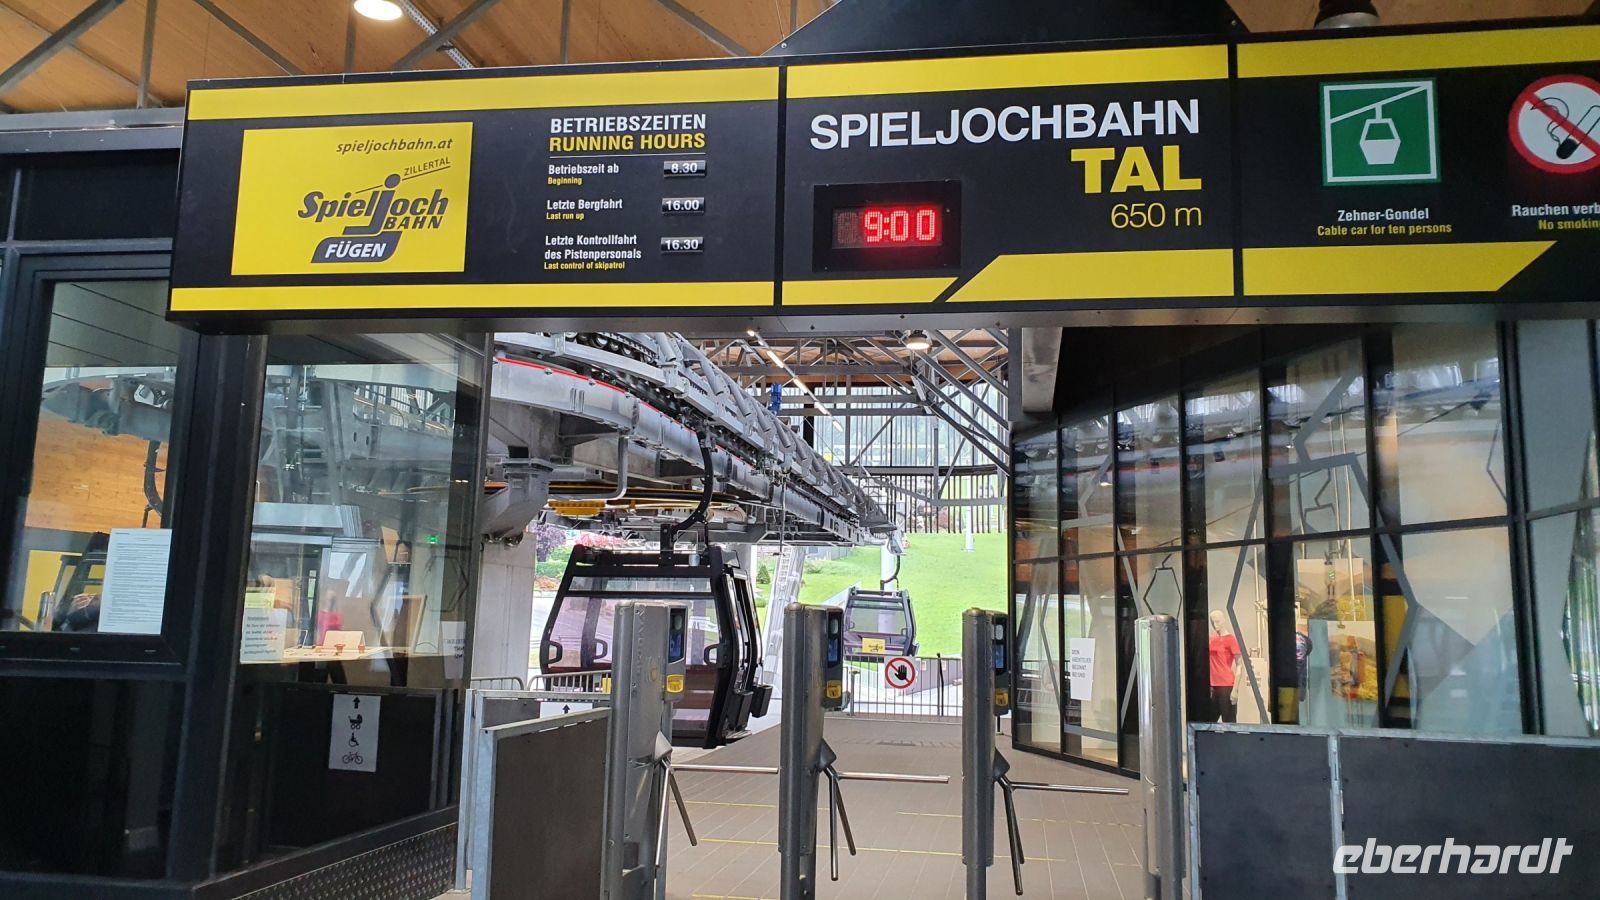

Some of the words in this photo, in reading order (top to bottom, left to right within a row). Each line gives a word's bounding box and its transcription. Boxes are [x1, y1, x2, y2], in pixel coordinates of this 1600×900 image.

[550, 113, 706, 134] BETRIEBSZEITEN
[810, 99, 1200, 150] SPIELJOCHBAHN
[336, 137, 453, 155] spieljochbahn.at
[549, 134, 634, 152] RUNNING
[640, 132, 705, 150] HOURS
[403, 156, 451, 176] ZILLERTAL
[548, 164, 605, 175] Betriebszeit
[607, 163, 620, 173] ab
[671, 162, 698, 174] 8.30
[1071, 144, 1203, 194] TAL
[547, 176, 583, 186] Beginning
[297, 173, 449, 235] Spieljoch
[546, 199, 576, 210] Letzte
[578, 199, 623, 211] Bergfahrt
[666, 199, 700, 211] 16.00
[1511, 203, 1570, 217] Rauchen
[546, 212, 561, 221] Last
[575, 213, 585, 221] up
[1111, 203, 1165, 229] 650
[1174, 207, 1202, 226] m
[1337, 207, 1429, 221] Zehner-Gondel
[383, 216, 443, 230] BAHN
[864, 209, 936, 243] 9:00
[1317, 225, 1348, 236] Cable
[1370, 224, 1386, 234] for
[1388, 224, 1406, 234] ten
[1408, 224, 1452, 236] persons
[1538, 220, 1554, 230] No
[545, 235, 574, 246] Letzte
[576, 234, 638, 245] Kontrollfahrt
[665, 239, 699, 250] 16.30
[325, 241, 387, 258] FÜGEN
[544, 250, 562, 260] des
[564, 249, 642, 261] Pistenpersonals
[544, 262, 559, 270] Last
[586, 261, 594, 269] of
[595, 261, 625, 271] skipatrol
